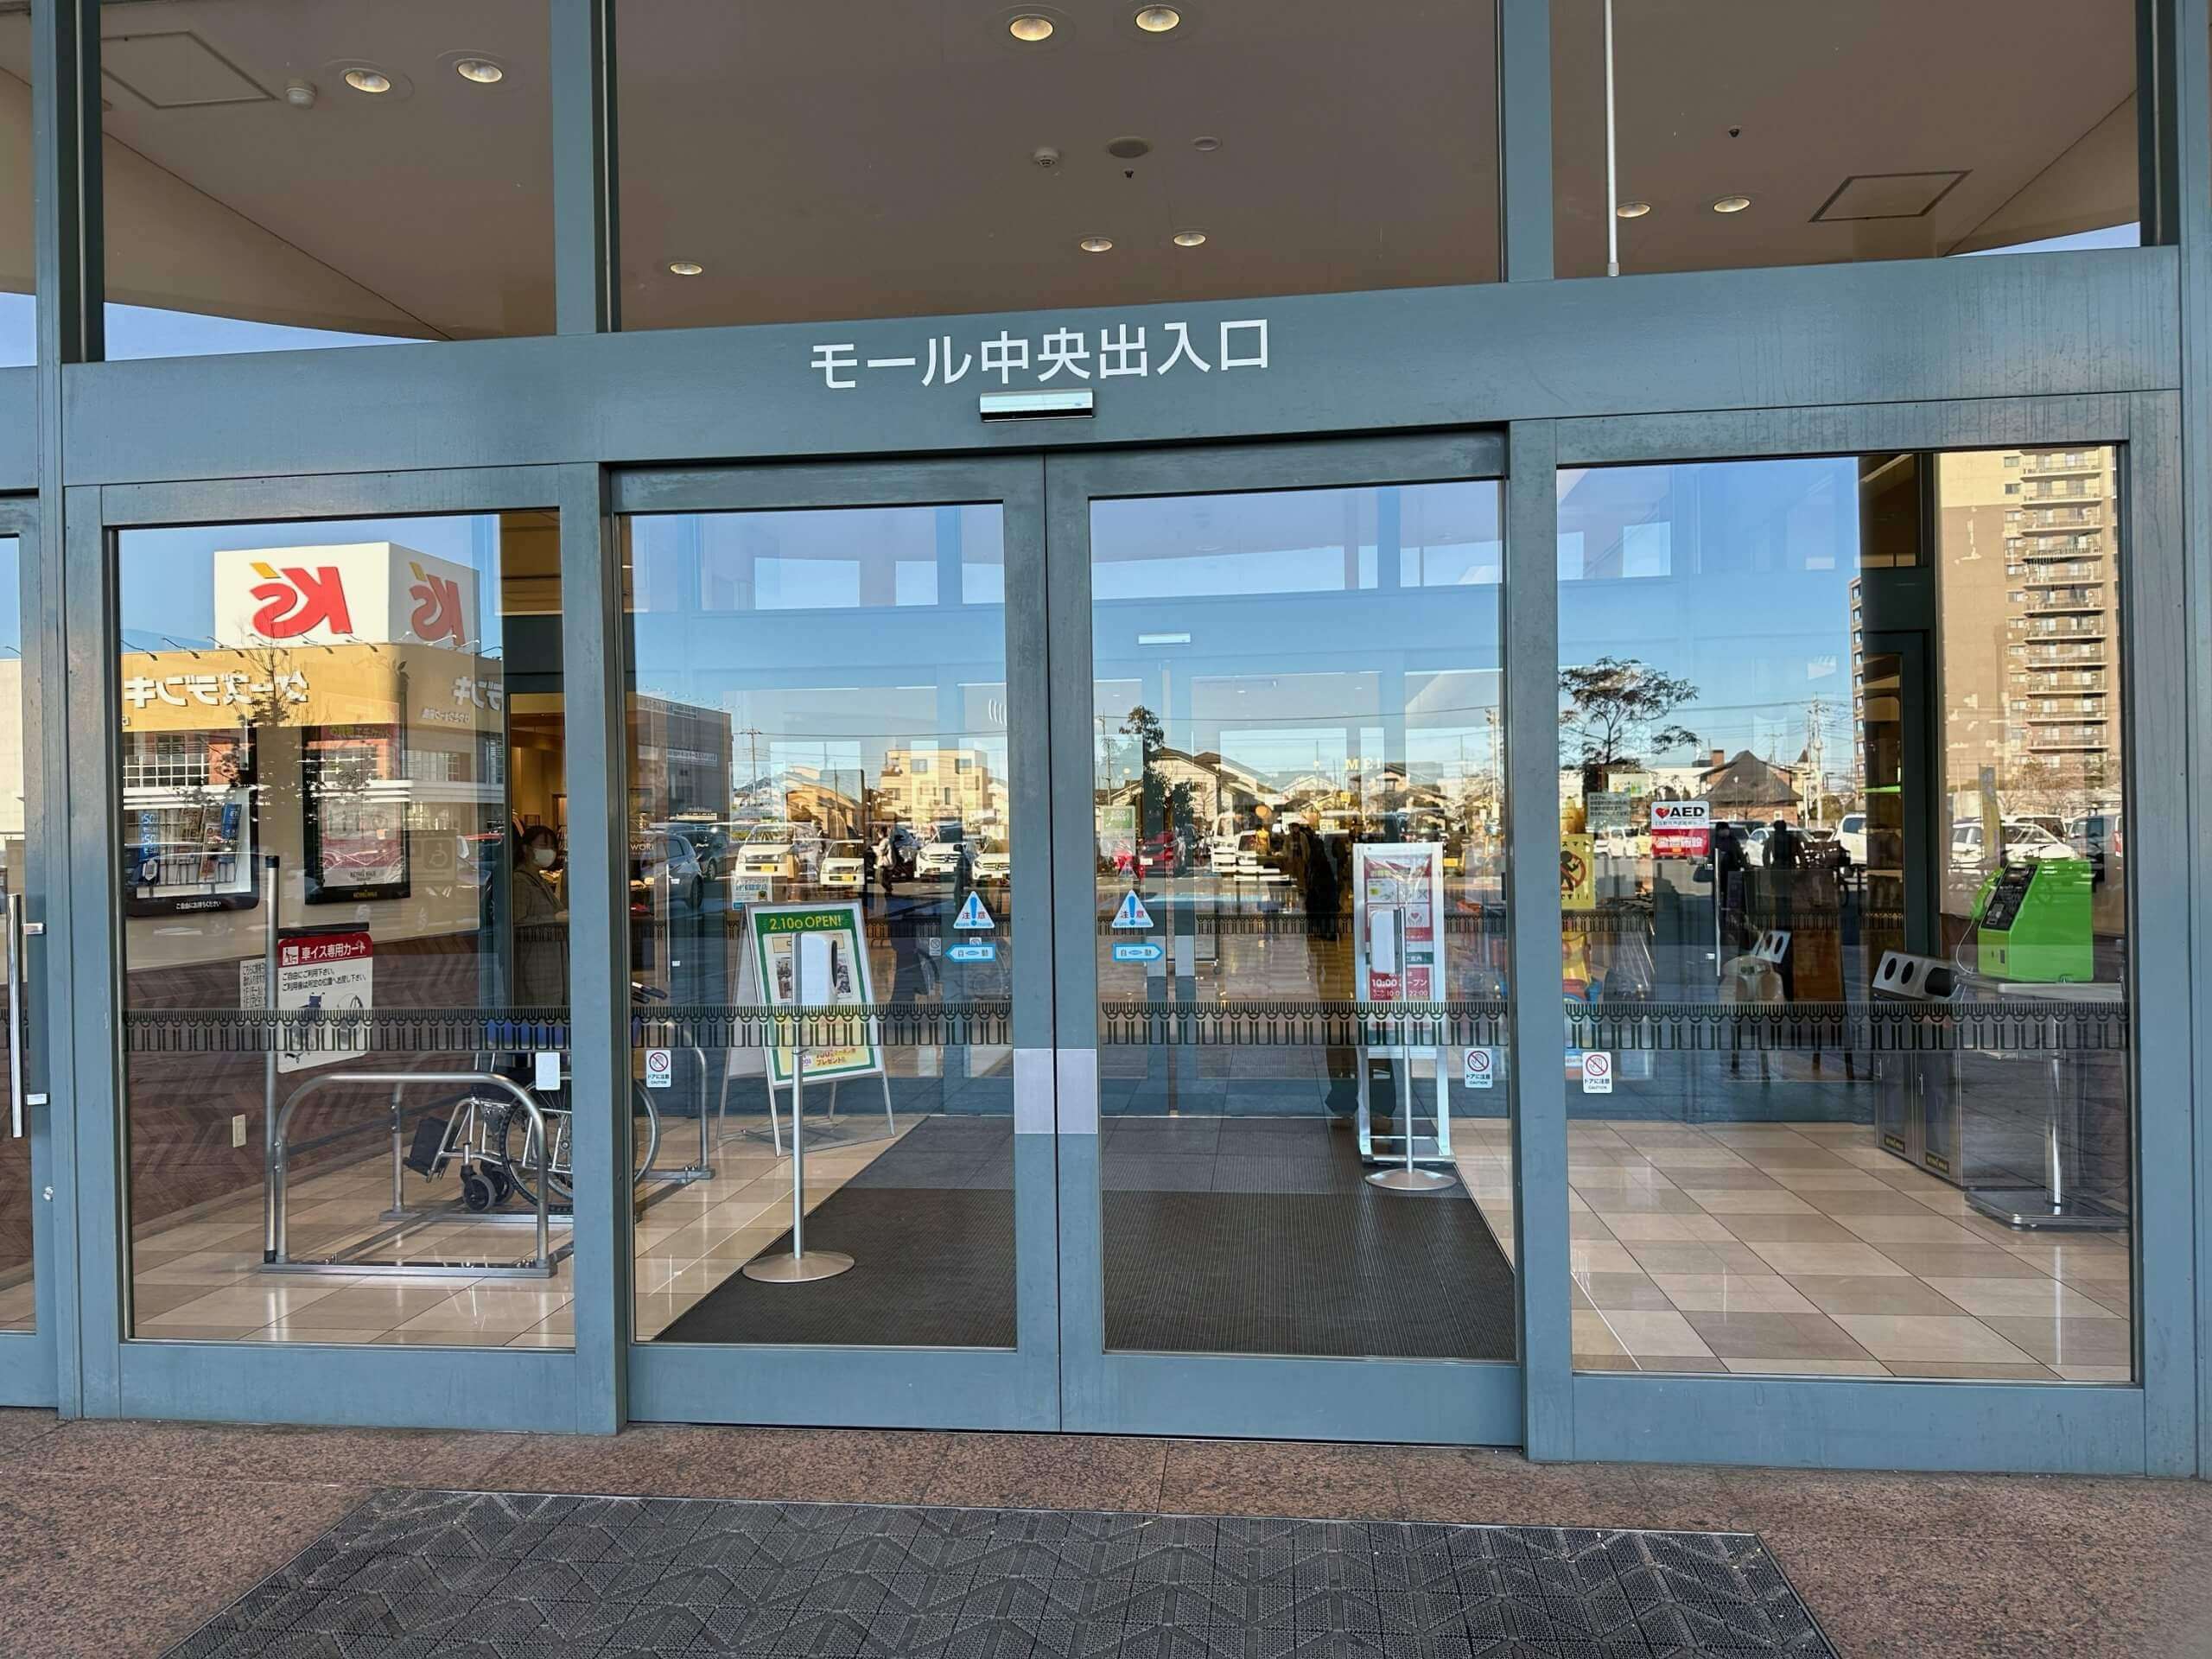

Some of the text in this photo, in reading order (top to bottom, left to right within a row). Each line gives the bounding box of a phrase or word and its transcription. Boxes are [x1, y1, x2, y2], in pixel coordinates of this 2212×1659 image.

[810, 318, 1269, 389] モール中央出入口
[1669, 806, 1705, 817] AED
[804, 915, 842, 928] OPEN!
[301, 940, 367, 960] 車イス専用カート
[1371, 978, 1397, 988] 10:00
